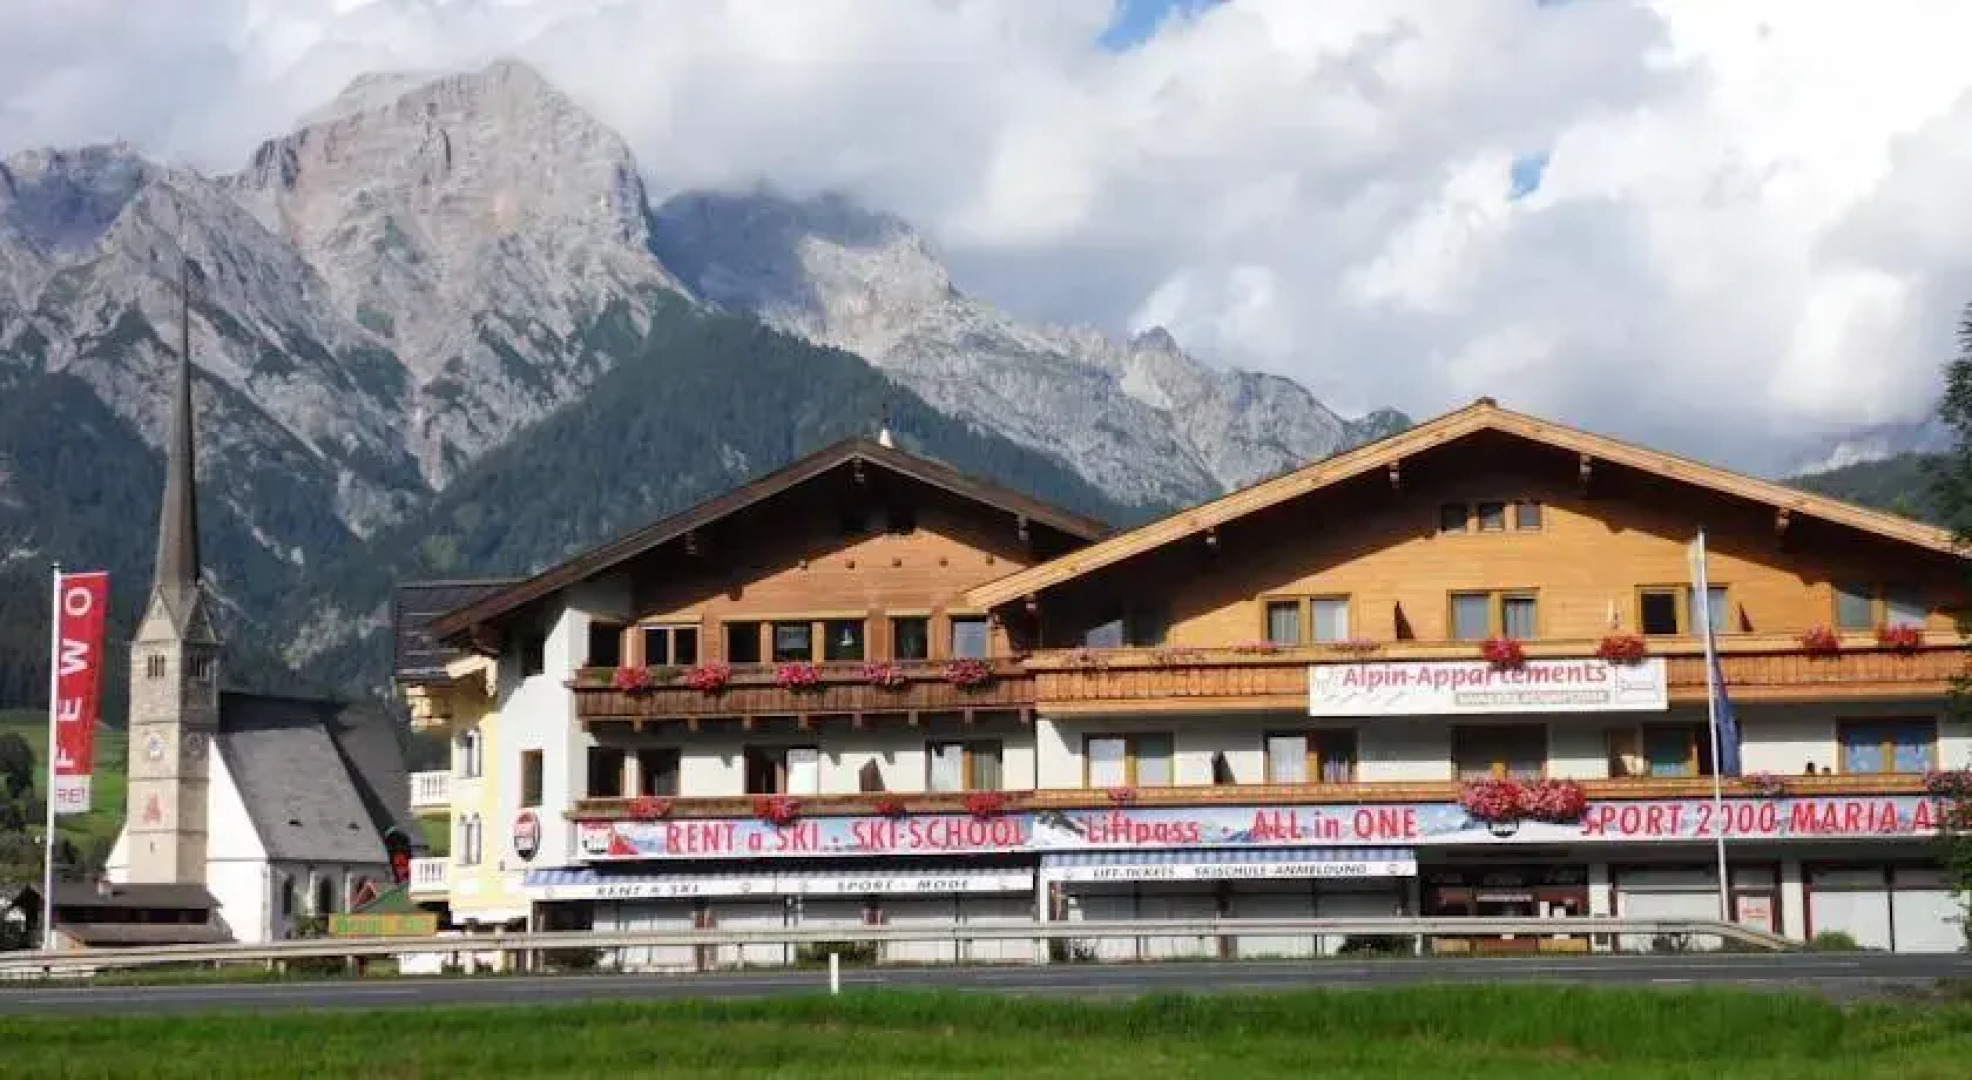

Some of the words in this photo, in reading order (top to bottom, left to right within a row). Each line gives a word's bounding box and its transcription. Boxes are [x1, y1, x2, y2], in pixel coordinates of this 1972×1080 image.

[55, 586, 93, 769] FEWO
[1342, 664, 1608, 692] Alpin-Appartements
[664, 822, 736, 855] RENT
[774, 822, 821, 850] SKI
[852, 816, 1026, 848] SKI-SCHOOL
[1086, 811, 1202, 844] Liftpass
[1253, 809, 1301, 840] ALL
[1313, 811, 1341, 838] in
[1353, 808, 1418, 839] ONE
[1580, 803, 1682, 836] SPORT
[1788, 801, 1898, 833] MARIA
